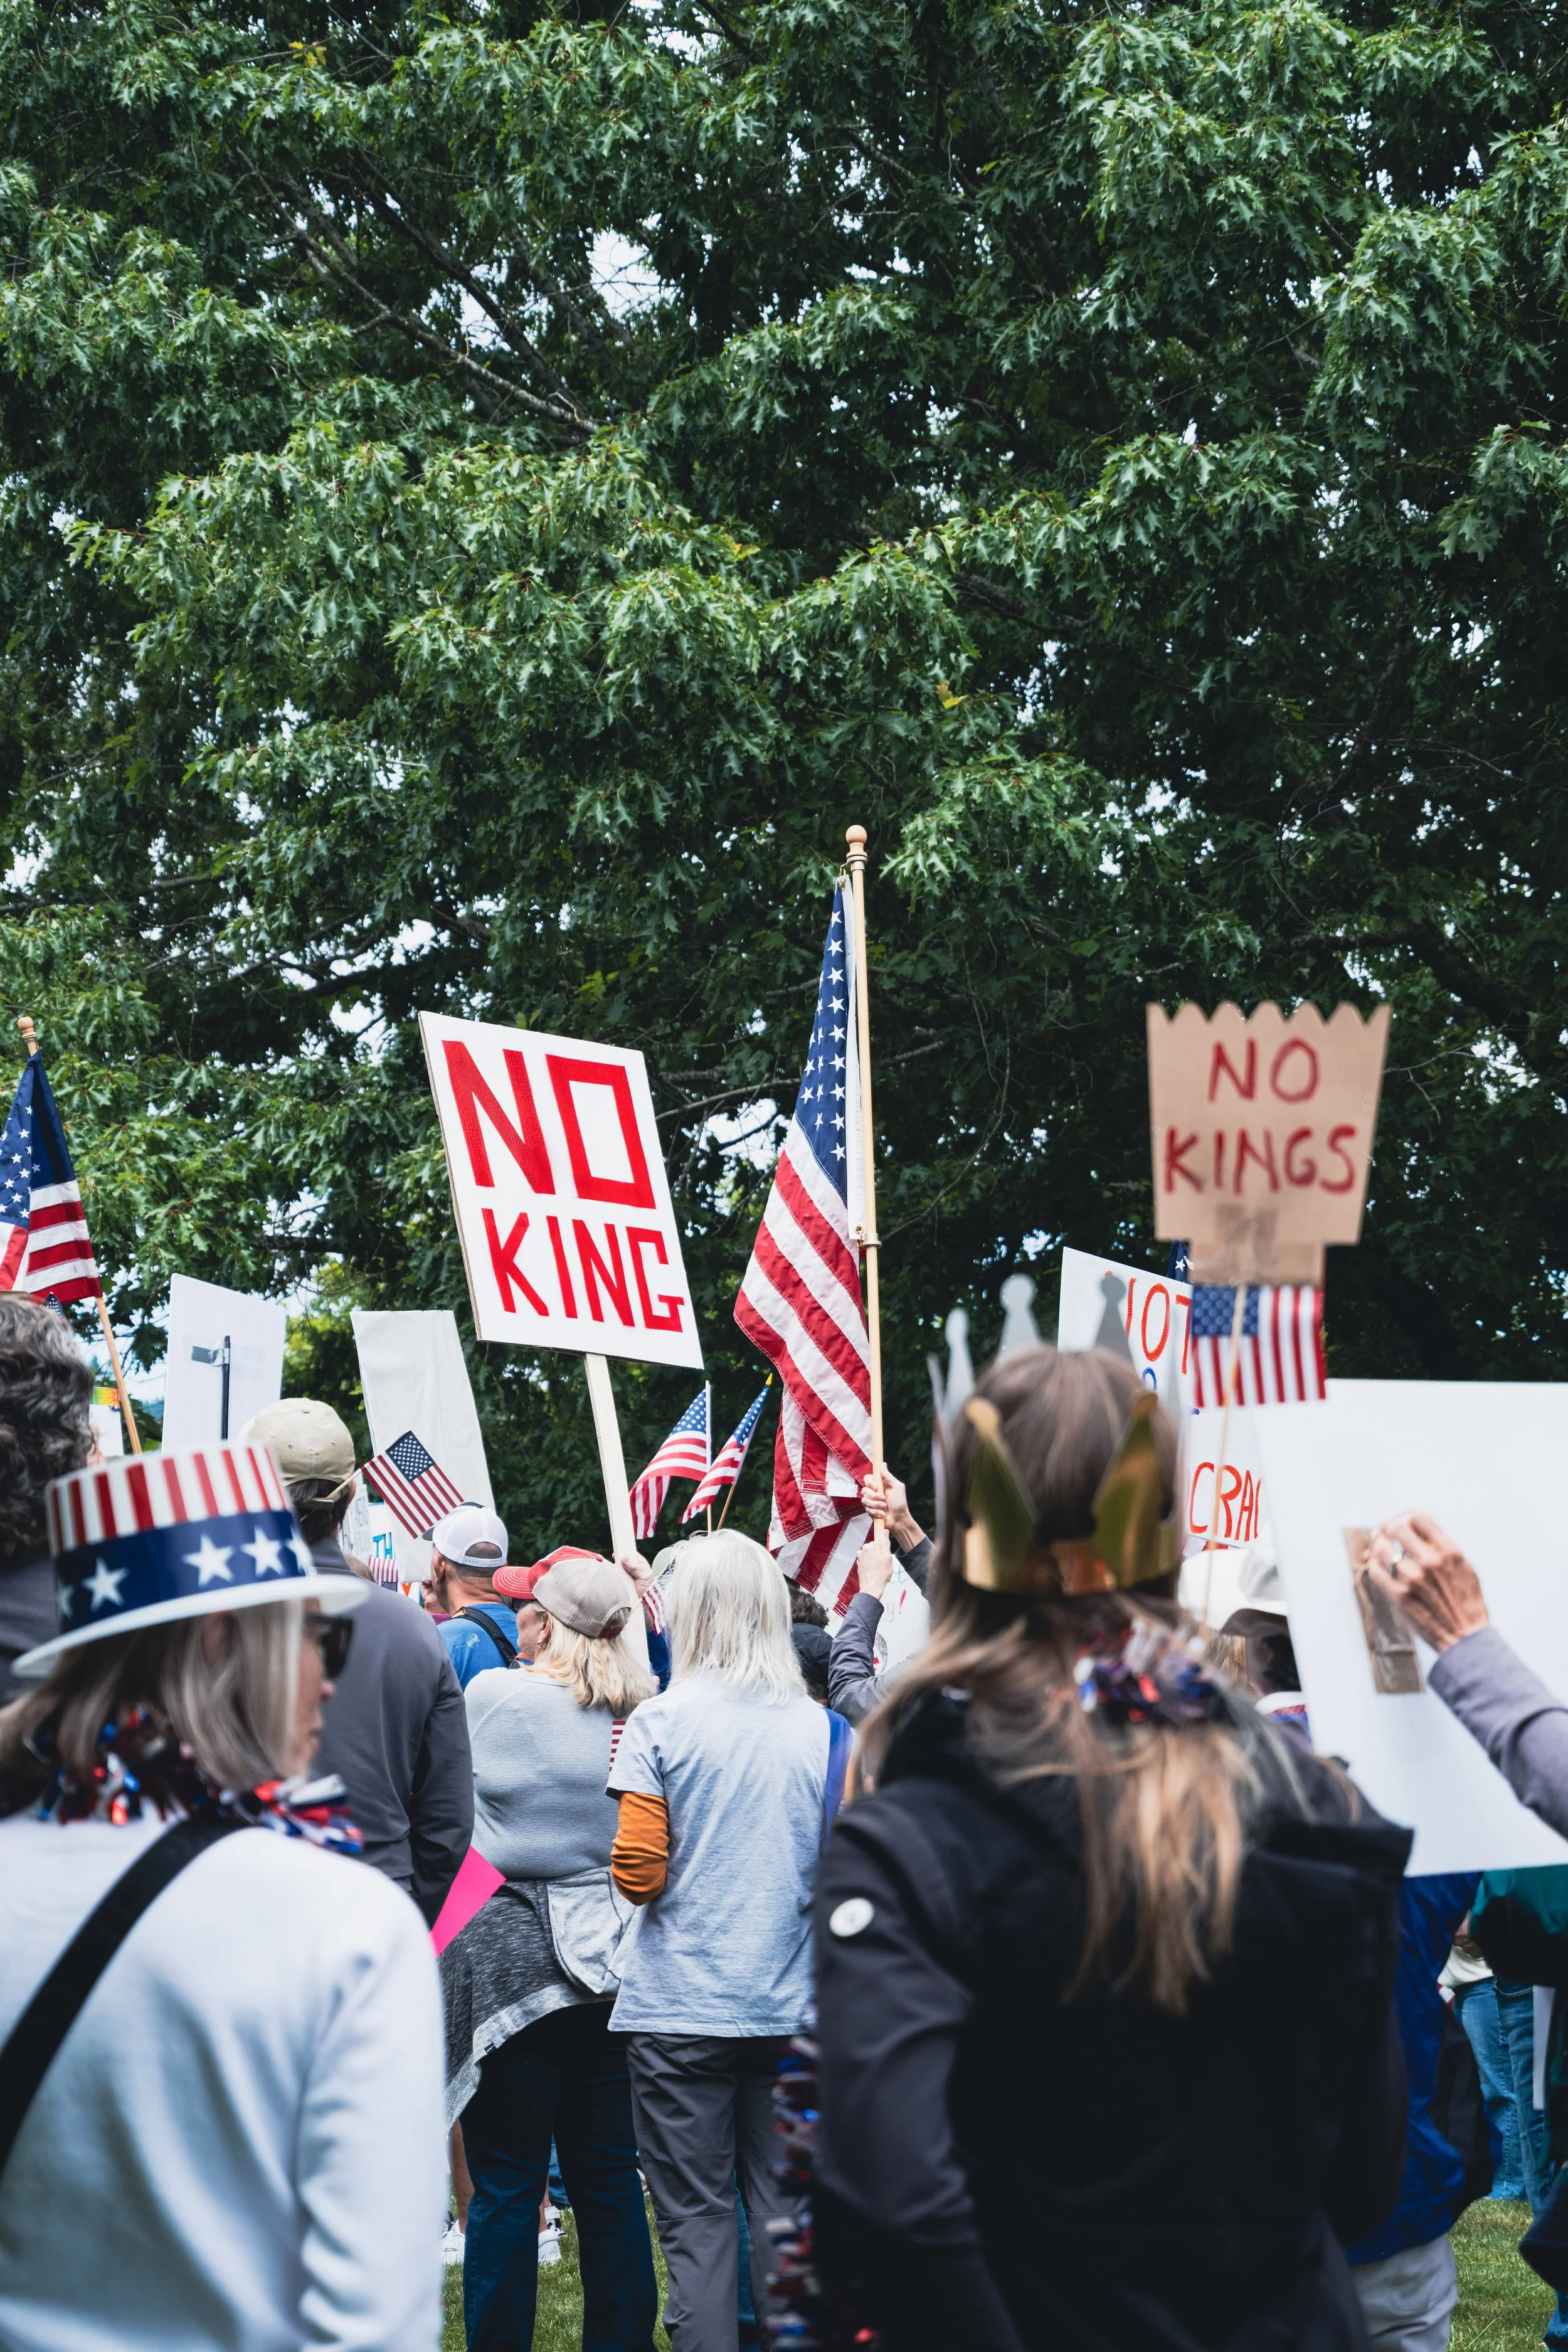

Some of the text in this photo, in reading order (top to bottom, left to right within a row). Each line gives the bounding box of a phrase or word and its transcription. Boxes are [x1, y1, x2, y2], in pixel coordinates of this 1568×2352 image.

[1208, 1036, 1320, 1103] NO
[442, 1040, 657, 1209] NO
[1164, 1123, 1358, 1195] KINGS
[481, 1207, 685, 1333] KING
